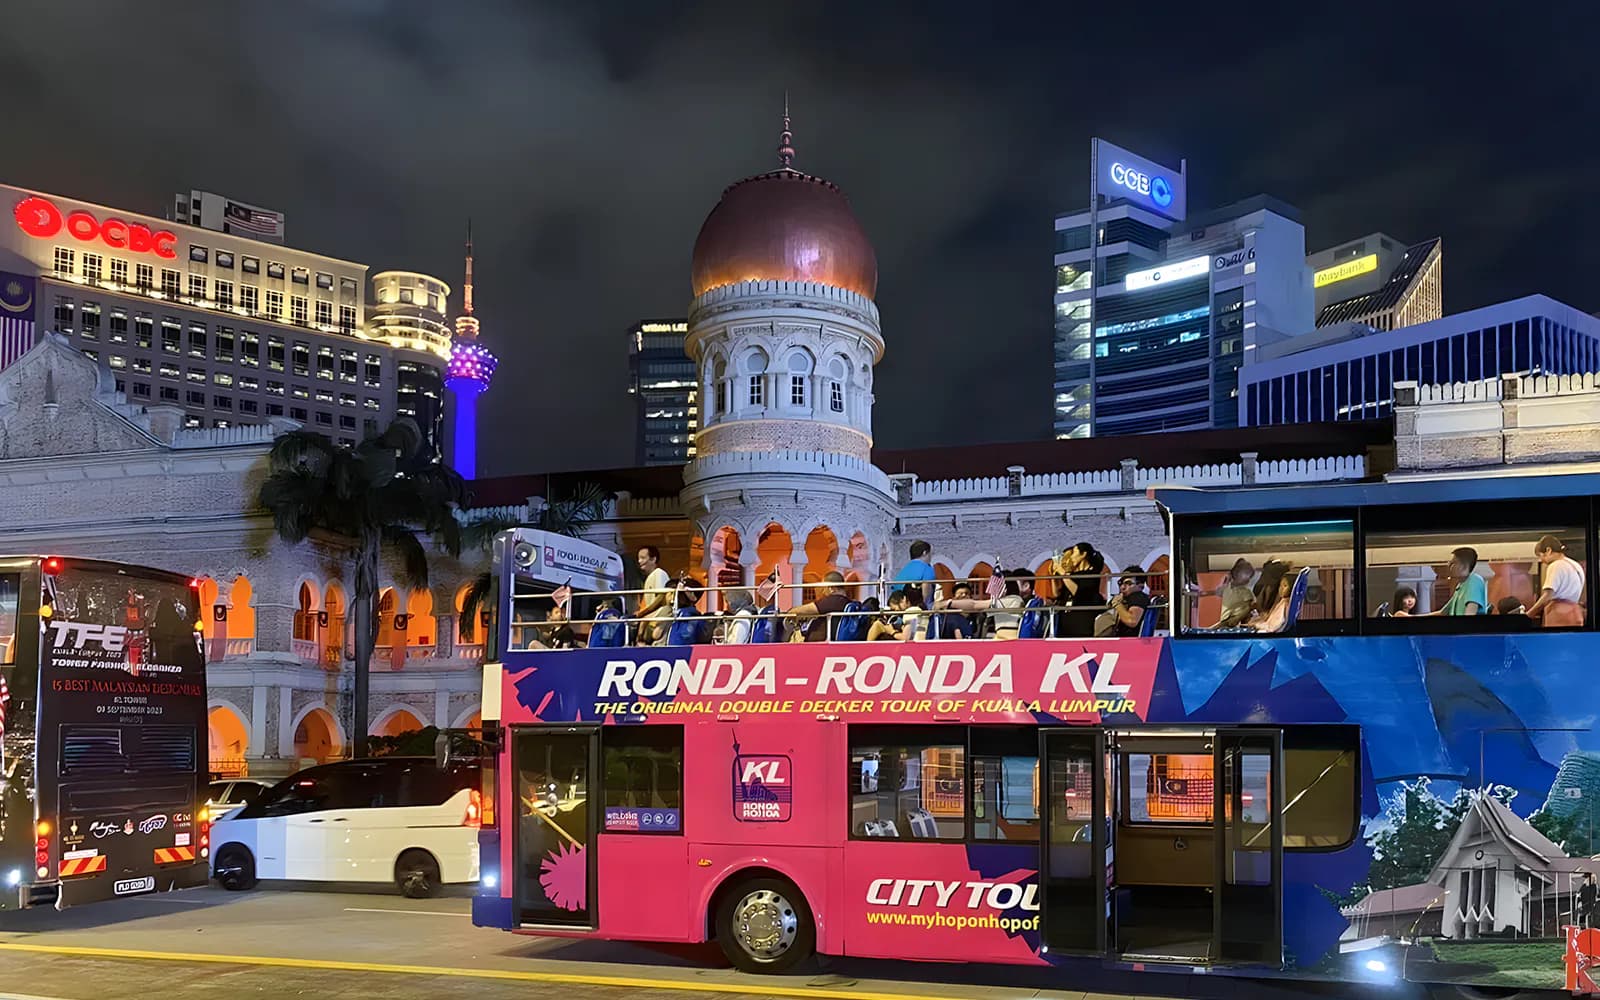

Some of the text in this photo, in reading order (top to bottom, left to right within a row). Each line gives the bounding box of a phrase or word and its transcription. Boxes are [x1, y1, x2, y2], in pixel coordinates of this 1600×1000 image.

[66, 209, 178, 260] OCBC
[50, 621, 128, 651] TFE
[597, 658, 776, 697] RONDA
[814, 654, 1014, 695] RONDA
[1039, 652, 1131, 694] KL
[593, 699, 1136, 715] THE ORIGINAL DOUBLE DECKER TOUR OF KUALA LUMPUR
[741, 761, 785, 783] KL
[865, 878, 961, 907] CITY
